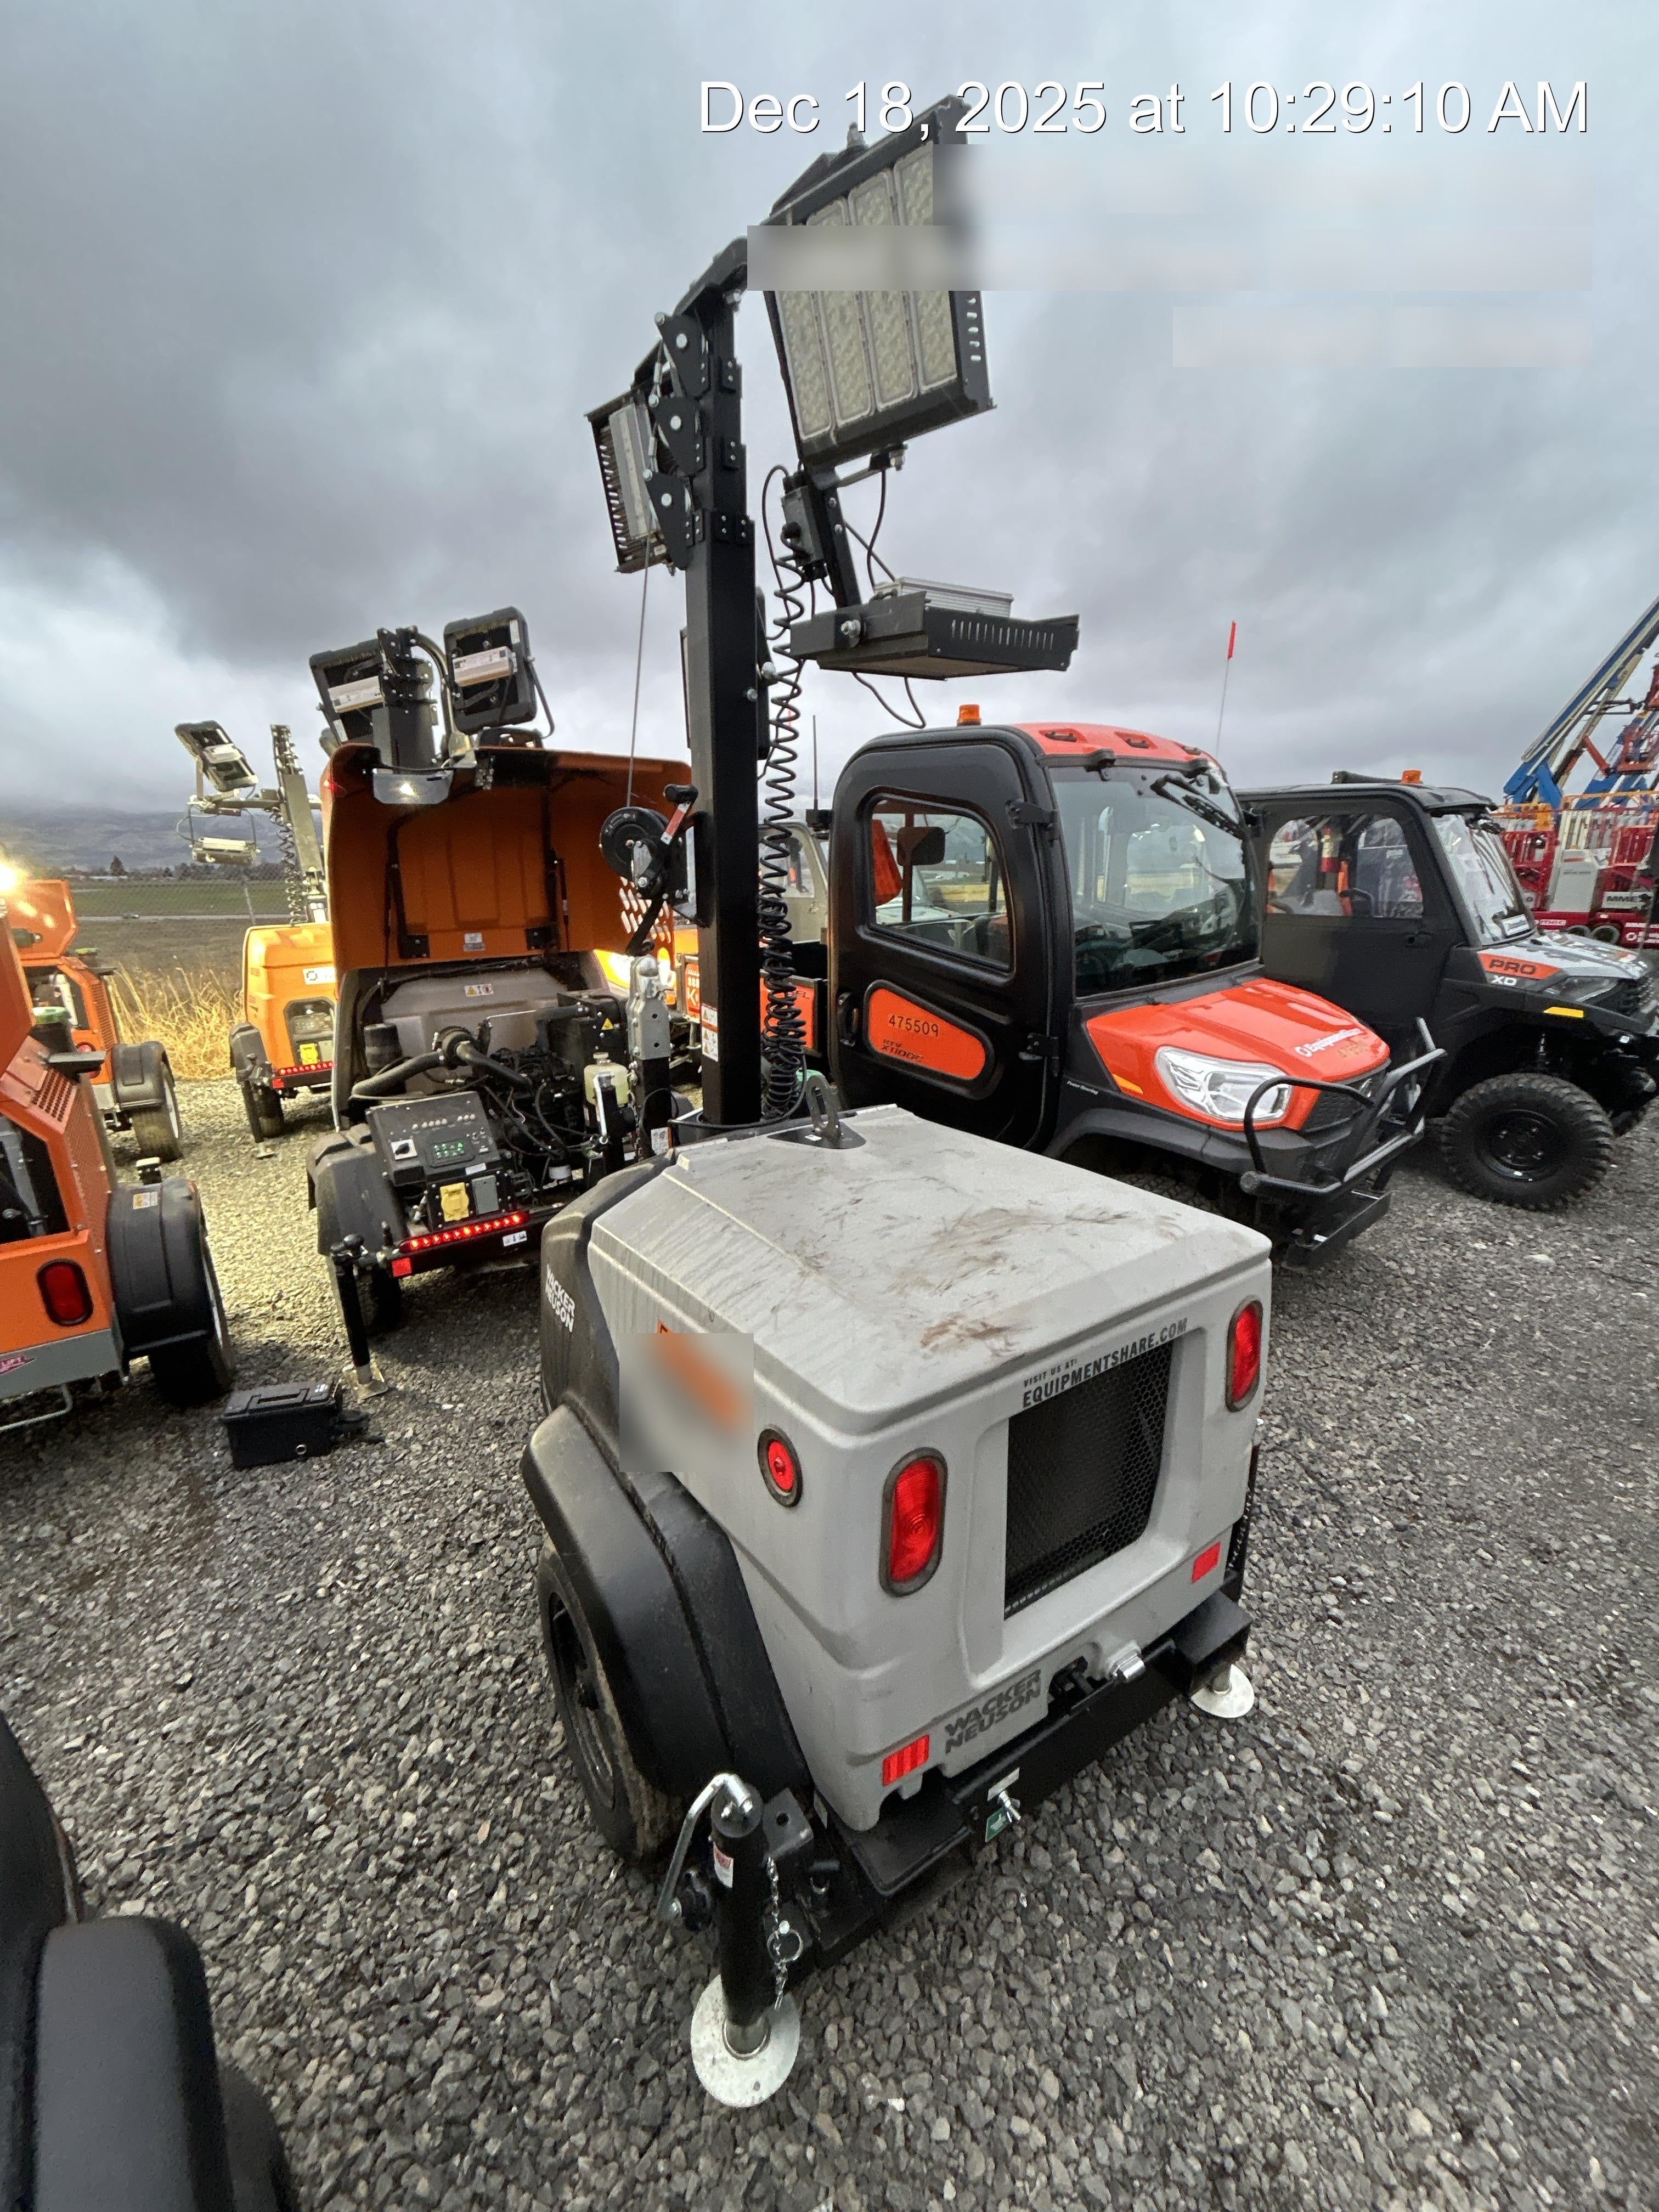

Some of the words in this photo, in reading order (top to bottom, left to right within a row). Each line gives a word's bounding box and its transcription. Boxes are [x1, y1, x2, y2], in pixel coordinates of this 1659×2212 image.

[1489, 959, 1537, 975] PRO
[1491, 975, 1517, 986] XD
[889, 1015, 938, 1037] 475509
[545, 1280, 574, 1333] NEUSON
[547, 1263, 575, 1318] WACKER
[1023, 1317, 1188, 1408] EQUIPMENTSHARE.COM
[1023, 1372, 1047, 1387] VISIT
[1051, 1365, 1062, 1375] US
[944, 1669, 1041, 1736] WACKER
[945, 1680, 1041, 1755] NEUSON
